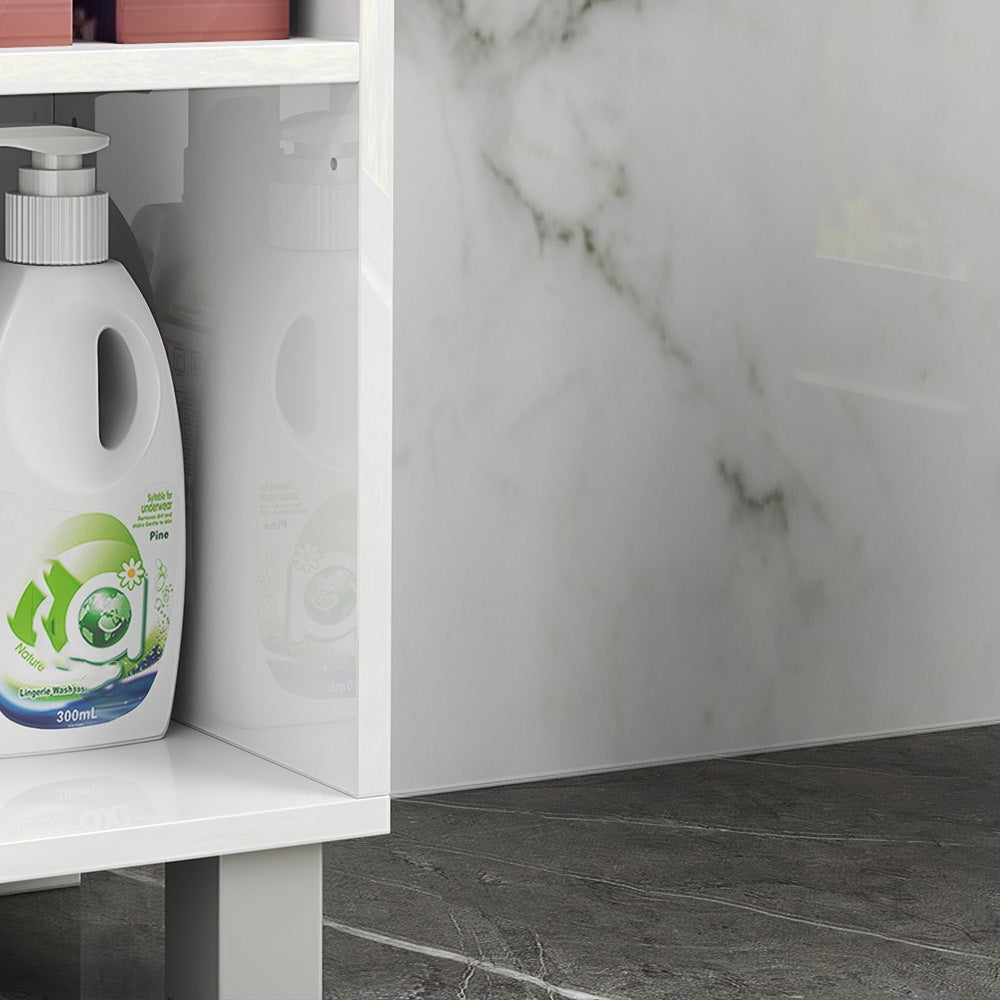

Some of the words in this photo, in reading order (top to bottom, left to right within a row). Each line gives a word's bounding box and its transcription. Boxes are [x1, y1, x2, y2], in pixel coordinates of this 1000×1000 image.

[149, 530, 169, 541] Pine
[14, 642, 45, 672] Nature
[19, 687, 51, 698] Lingerie
[56, 707, 98, 723] 300mL
